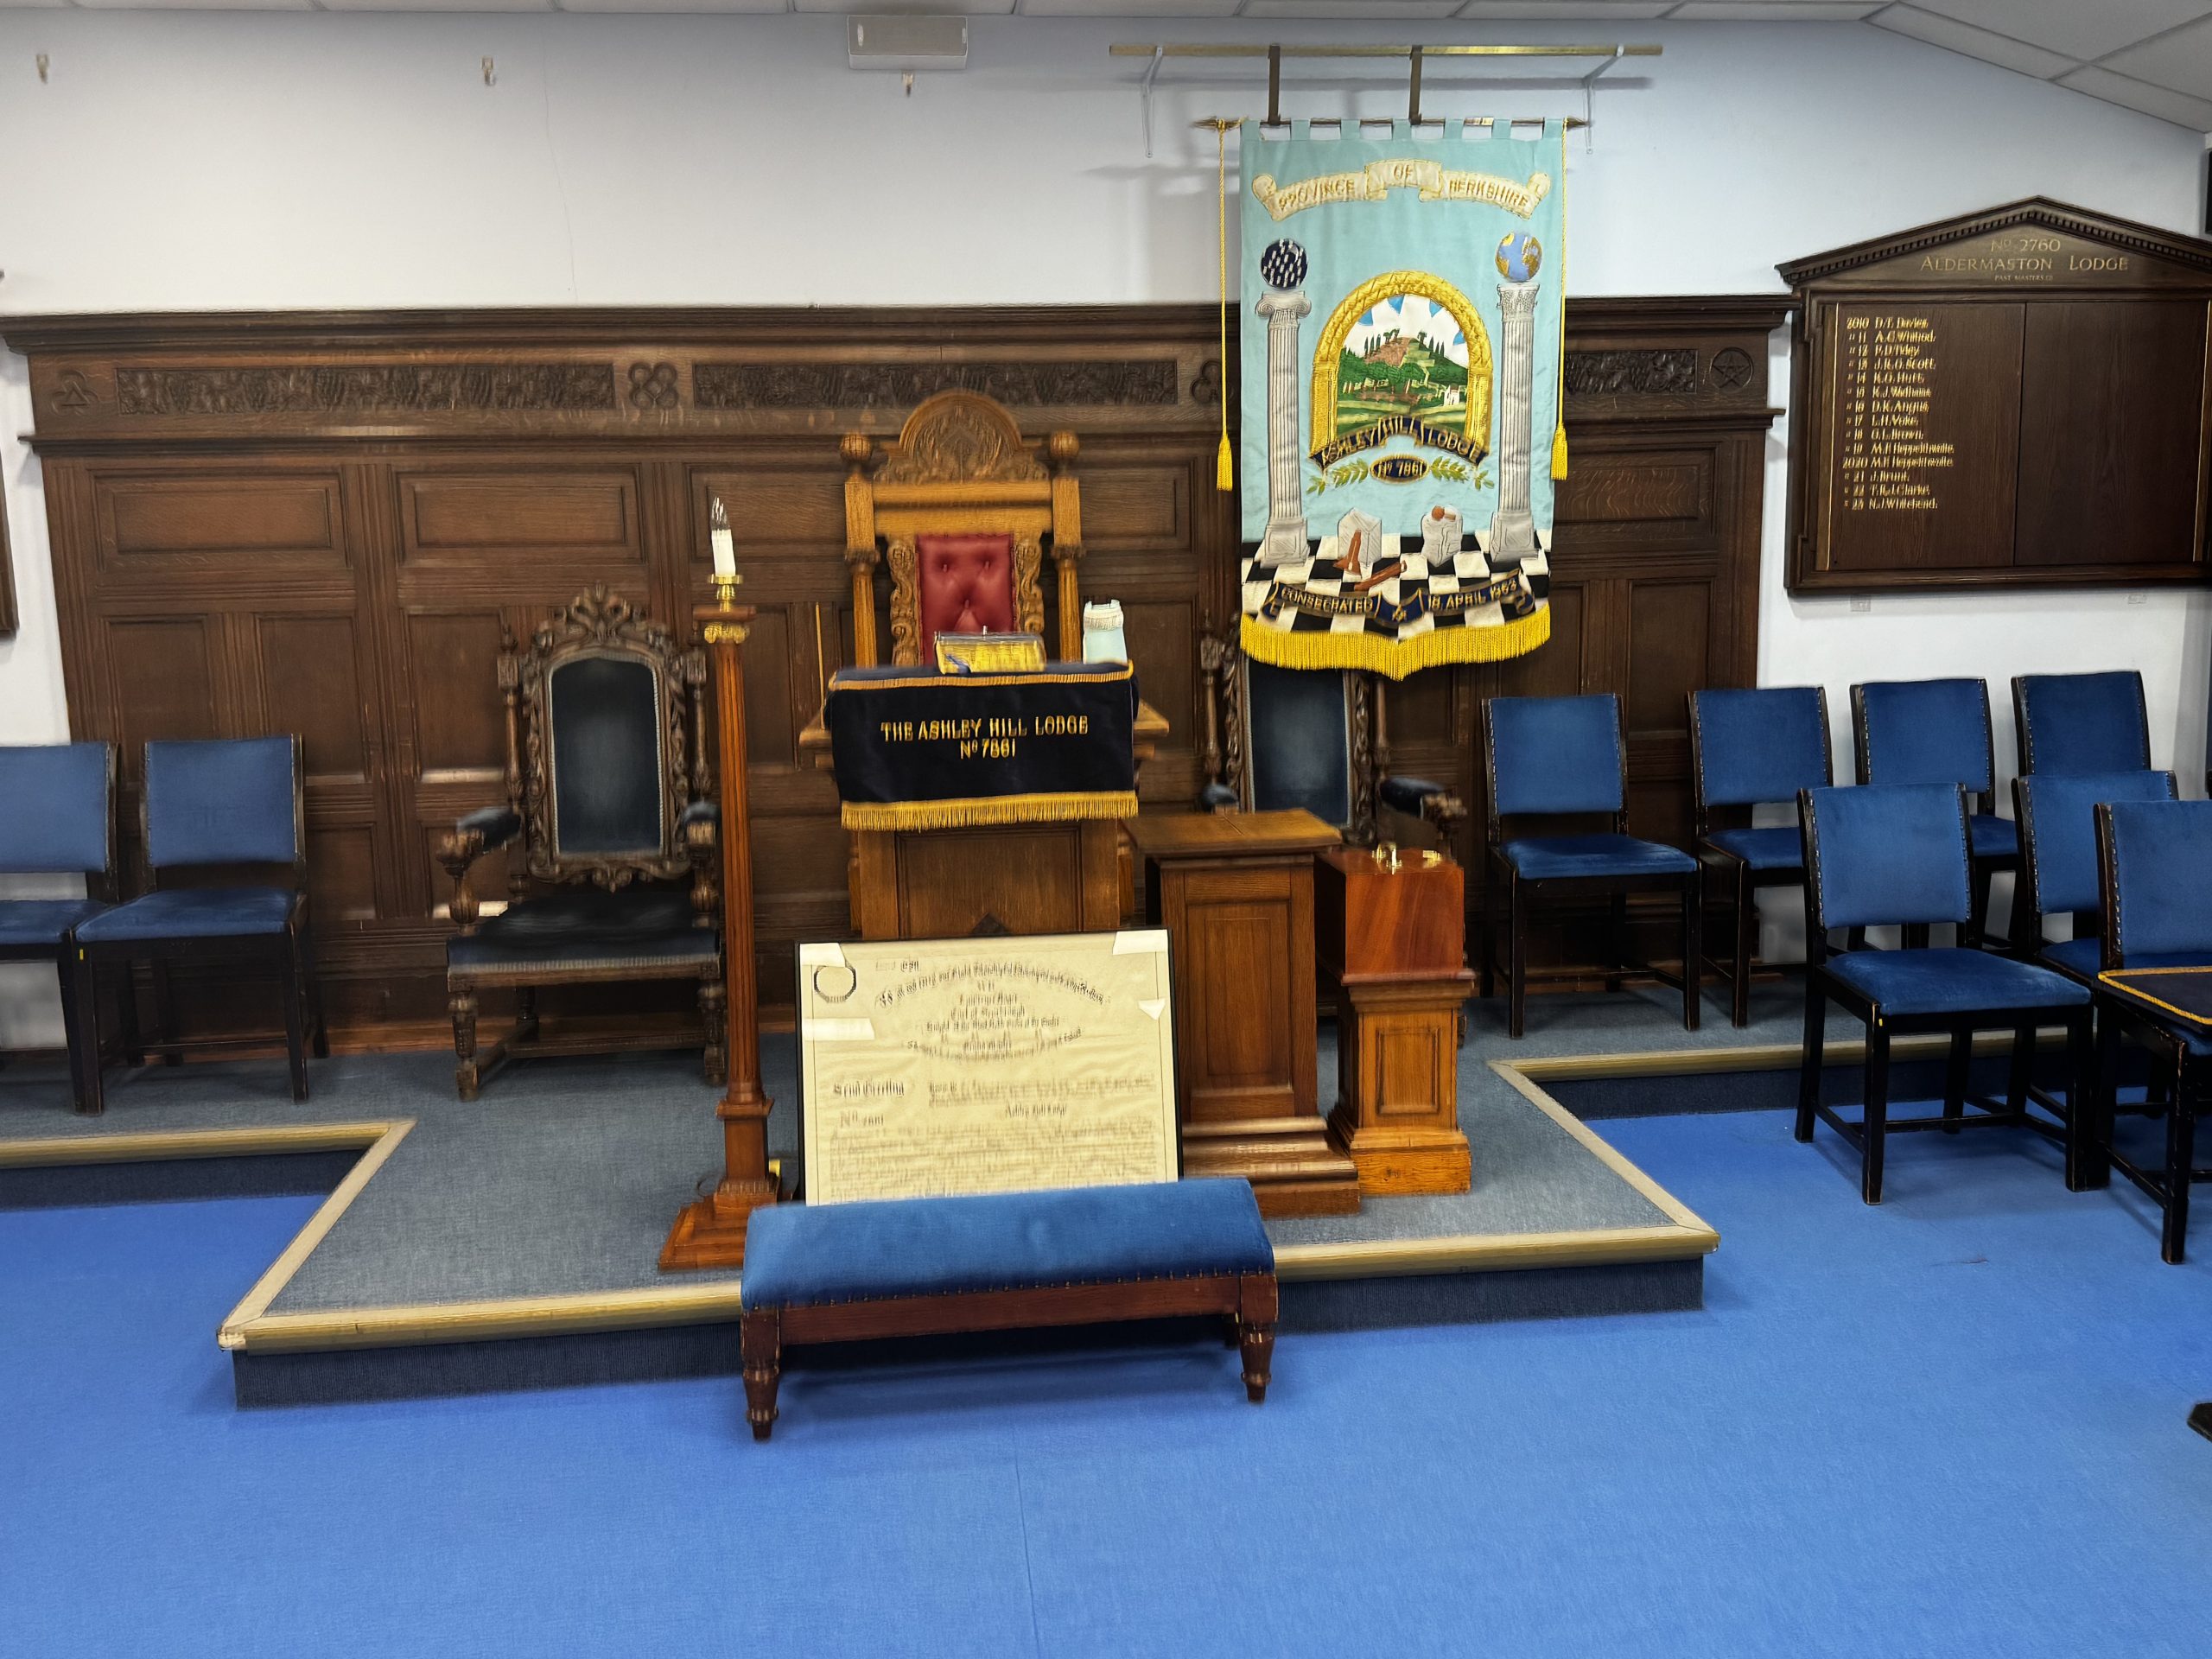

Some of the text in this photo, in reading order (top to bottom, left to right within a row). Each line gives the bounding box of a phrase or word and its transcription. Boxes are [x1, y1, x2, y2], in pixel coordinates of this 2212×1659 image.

[1393, 164, 1414, 181] OF
[2019, 238, 2061, 252] 2760
[1920, 255, 2052, 271] ALDERMASTON
[1847, 316, 1870, 329] 2010
[1428, 427, 1483, 463] LODGE
[880, 715, 1089, 742] THE ASHLEY HILL LODGE
